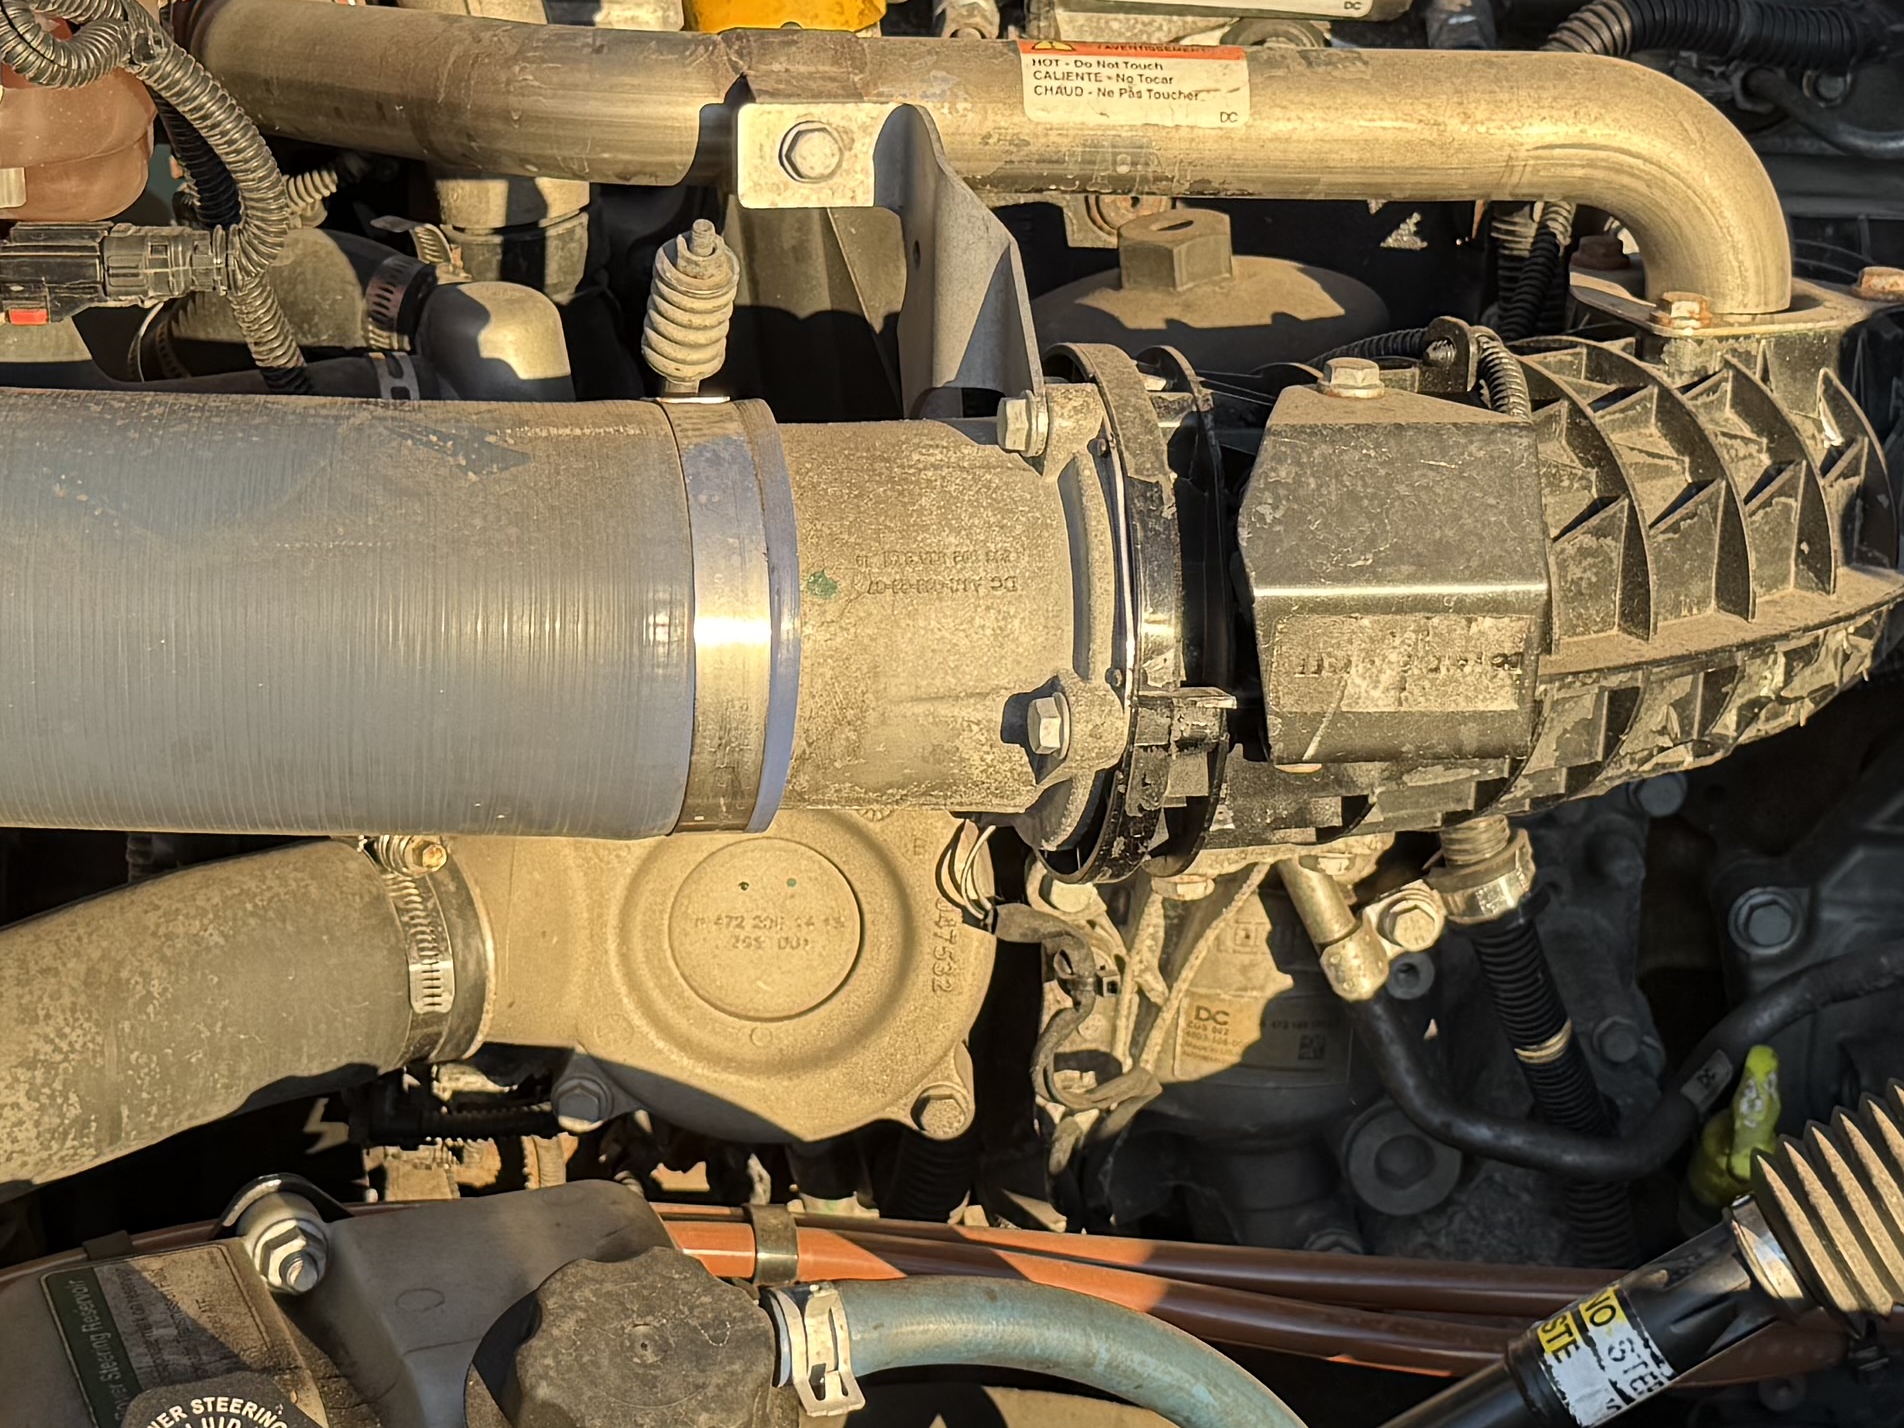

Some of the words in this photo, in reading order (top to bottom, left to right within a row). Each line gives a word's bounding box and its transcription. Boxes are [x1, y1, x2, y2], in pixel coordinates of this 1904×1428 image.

[1032, 58, 1061, 71] HOT
[1073, 59, 1094, 71] Do
[1096, 59, 1120, 72] Not
[1122, 60, 1164, 73] Touch
[1033, 70, 1103, 85] CALIENTE
[1115, 73, 1134, 86] No
[1138, 73, 1174, 87] Tocar
[1033, 83, 1084, 98] CHAUD
[1147, 88, 1200, 103] Toucher
[1219, 110, 1239, 125] DC
[1194, 1004, 1231, 1026] DC
